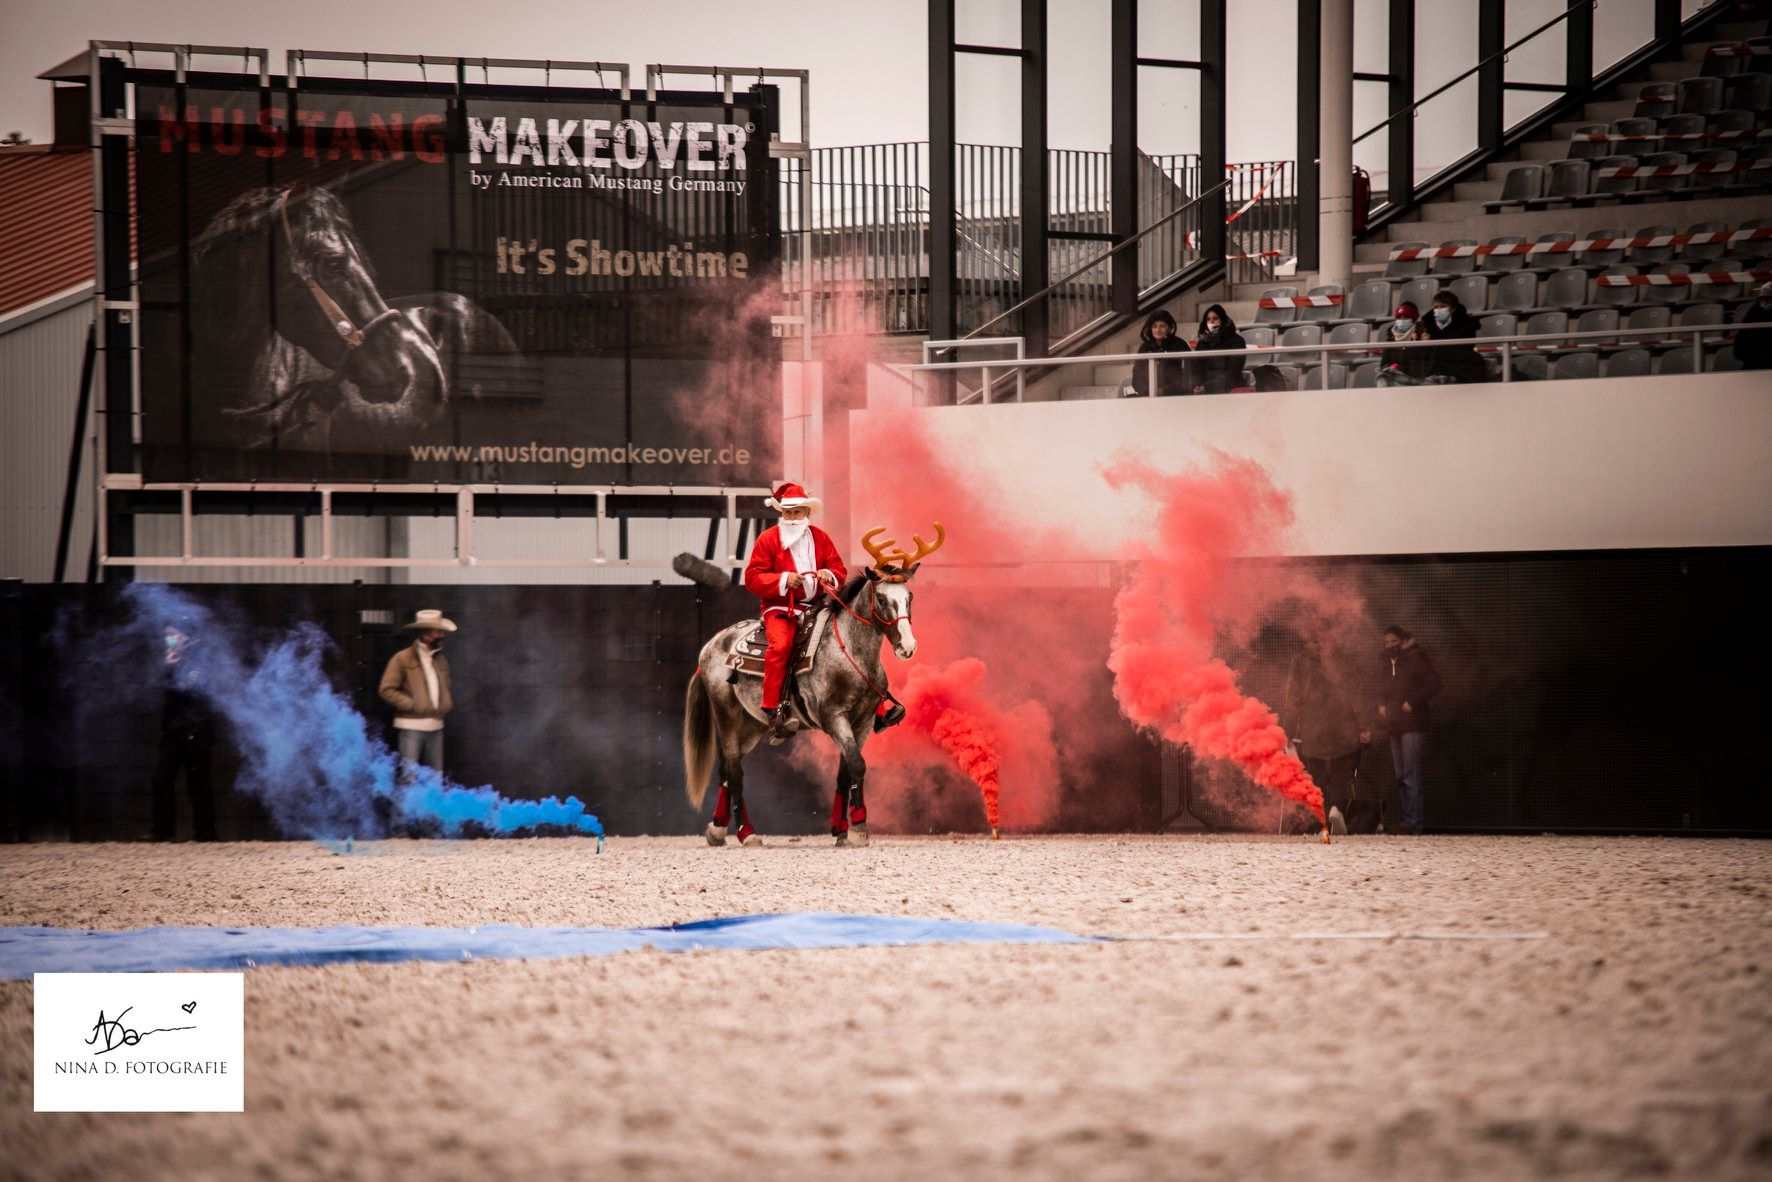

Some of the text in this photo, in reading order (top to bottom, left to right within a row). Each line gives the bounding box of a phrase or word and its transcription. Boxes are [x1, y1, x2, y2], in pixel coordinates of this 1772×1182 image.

[158, 105, 447, 164] MUSTANG
[470, 171, 746, 196] by American Mustang Germany
[496, 236, 749, 278] It's Showtime
[410, 442, 751, 469] www.mustangmakeover.de
